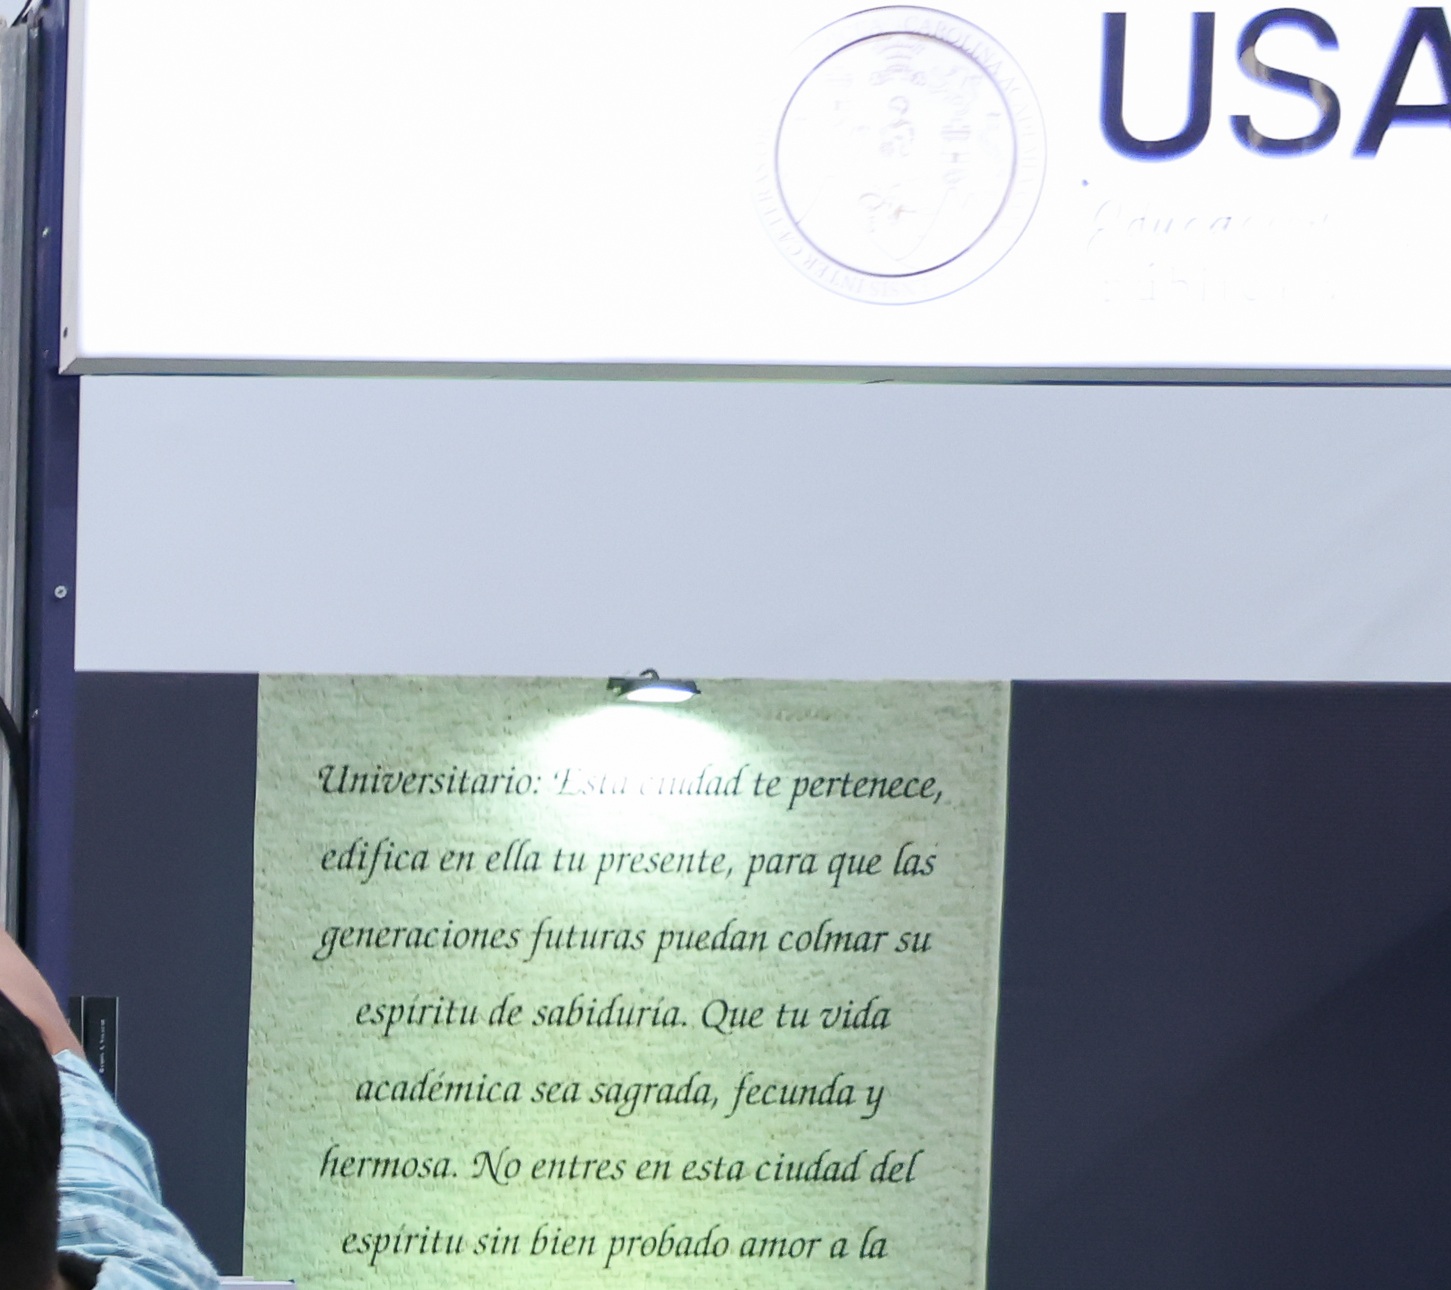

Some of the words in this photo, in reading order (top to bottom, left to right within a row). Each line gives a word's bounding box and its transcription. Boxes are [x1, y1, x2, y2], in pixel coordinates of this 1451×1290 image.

[319, 765, 537, 795] Universitario:
[754, 773, 781, 797] te
[787, 772, 942, 811] pertenece,
[321, 837, 429, 884] edifica
[440, 850, 475, 872] en
[486, 839, 540, 872] ella
[553, 849, 585, 872] tu
[594, 849, 732, 885] presente,
[743, 853, 818, 887] para
[828, 852, 881, 888] que
[893, 841, 936, 876] las
[312, 920, 521, 961] generaciones
[523, 916, 646, 963] futuras
[652, 918, 768, 963] puedan
[778, 918, 889, 952] colmar
[894, 932, 931, 953] su
[356, 995, 477, 1039] espíritu
[489, 996, 522, 1026] de
[532, 993, 687, 1028] sabiduría.
[702, 999, 764, 1035] Que
[777, 1004, 809, 1028] tu
[820, 995, 891, 1030] vida
[356, 1071, 521, 1103] académica
[531, 1081, 581, 1103] sea
[589, 1071, 718, 1117] sagrada,
[724, 1071, 856, 1118] fecunda
[860, 1086, 884, 1120] y
[320, 1144, 457, 1178] hermosa.
[471, 1150, 521, 1186] No
[531, 1155, 626, 1180] entres
[636, 1160, 671, 1181] en
[682, 1156, 745, 1181] esta
[755, 1149, 865, 1182] ciudad
[870, 1149, 925, 1183] del
[342, 1224, 463, 1267] espíritu
[473, 1227, 519, 1255] sin
[530, 1227, 595, 1256] bien
[603, 1224, 729, 1269] probado
[739, 1237, 822, 1258] amor
[830, 1238, 849, 1259] a
[859, 1226, 888, 1259] la
